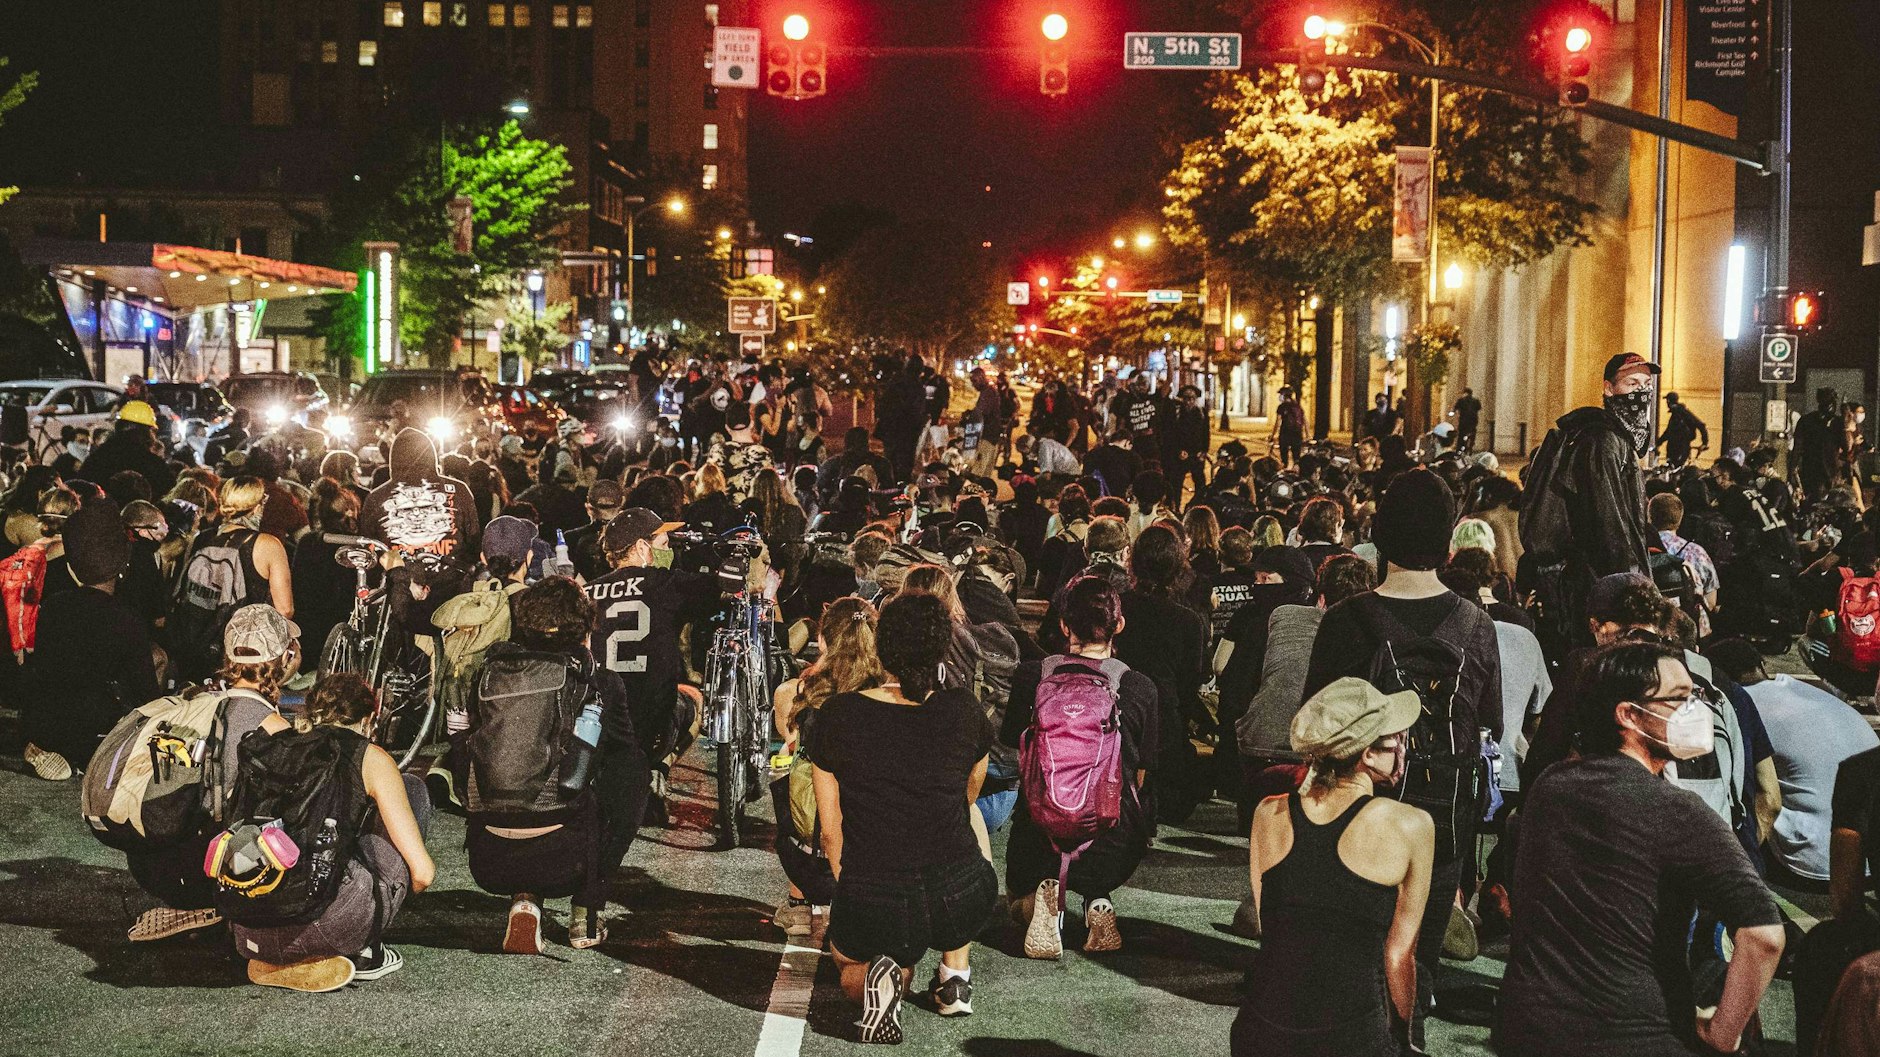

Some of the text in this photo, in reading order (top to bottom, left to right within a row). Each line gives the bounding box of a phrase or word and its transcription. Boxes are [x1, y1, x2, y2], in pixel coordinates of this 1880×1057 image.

[1699, 5, 1722, 13] Visitor
[1711, 21, 1746, 29] Riverfront
[1712, 36, 1737, 44] Theater
[724, 43, 751, 52] YIELD
[1133, 37, 1231, 55] N. 5th St
[1717, 52, 1733, 60] First
[1133, 56, 1231, 66] 200 300
[1715, 69, 1746, 77] Complex
[1775, 343, 1786, 357] P
[1212, 584, 1249, 593] STAND
[1211, 592, 1254, 602] QUAL
[1063, 703, 1085, 711] OSPREY
